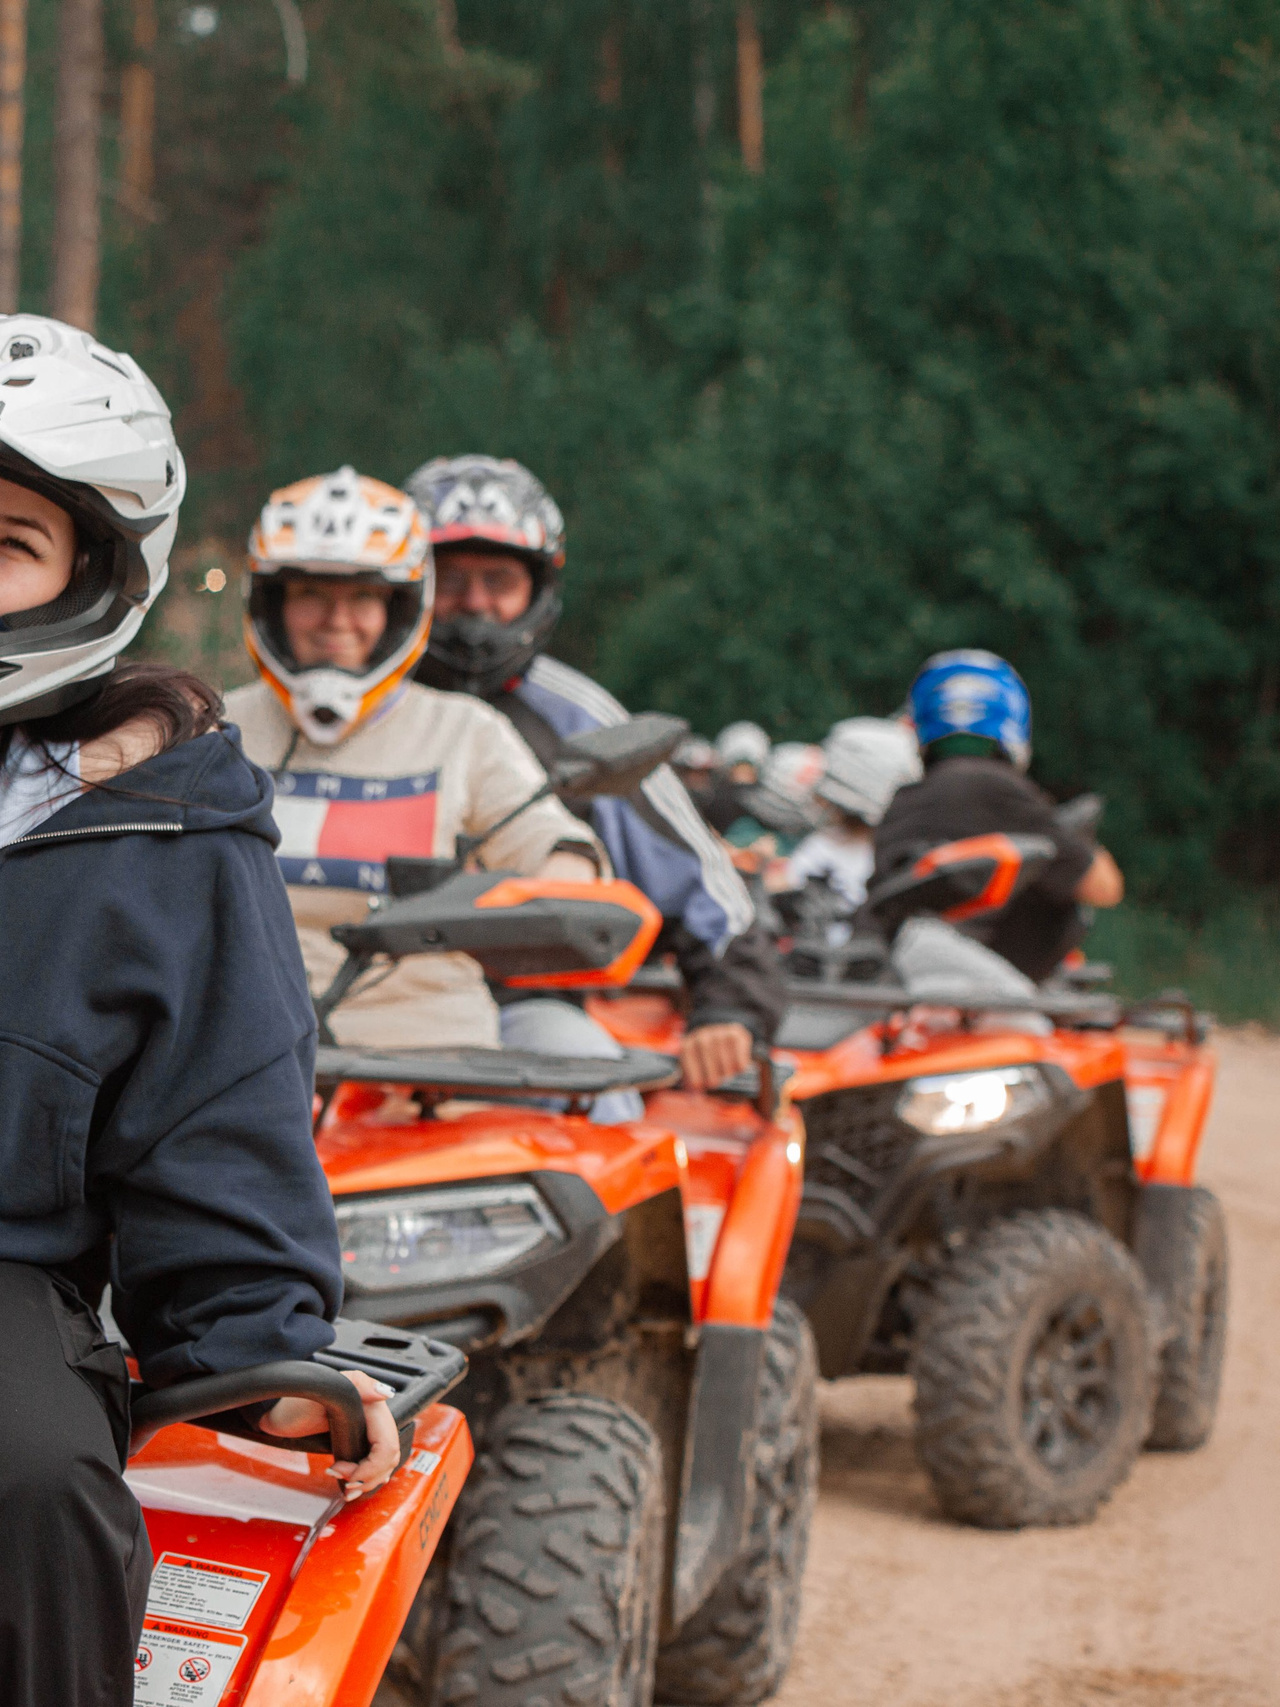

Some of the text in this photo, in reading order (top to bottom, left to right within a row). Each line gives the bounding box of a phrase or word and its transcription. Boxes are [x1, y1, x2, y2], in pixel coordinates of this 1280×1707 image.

[196, 1563, 243, 1577] WARNING
[164, 1625, 209, 1639] WARNING
[183, 1641, 210, 1650] SAFETY
